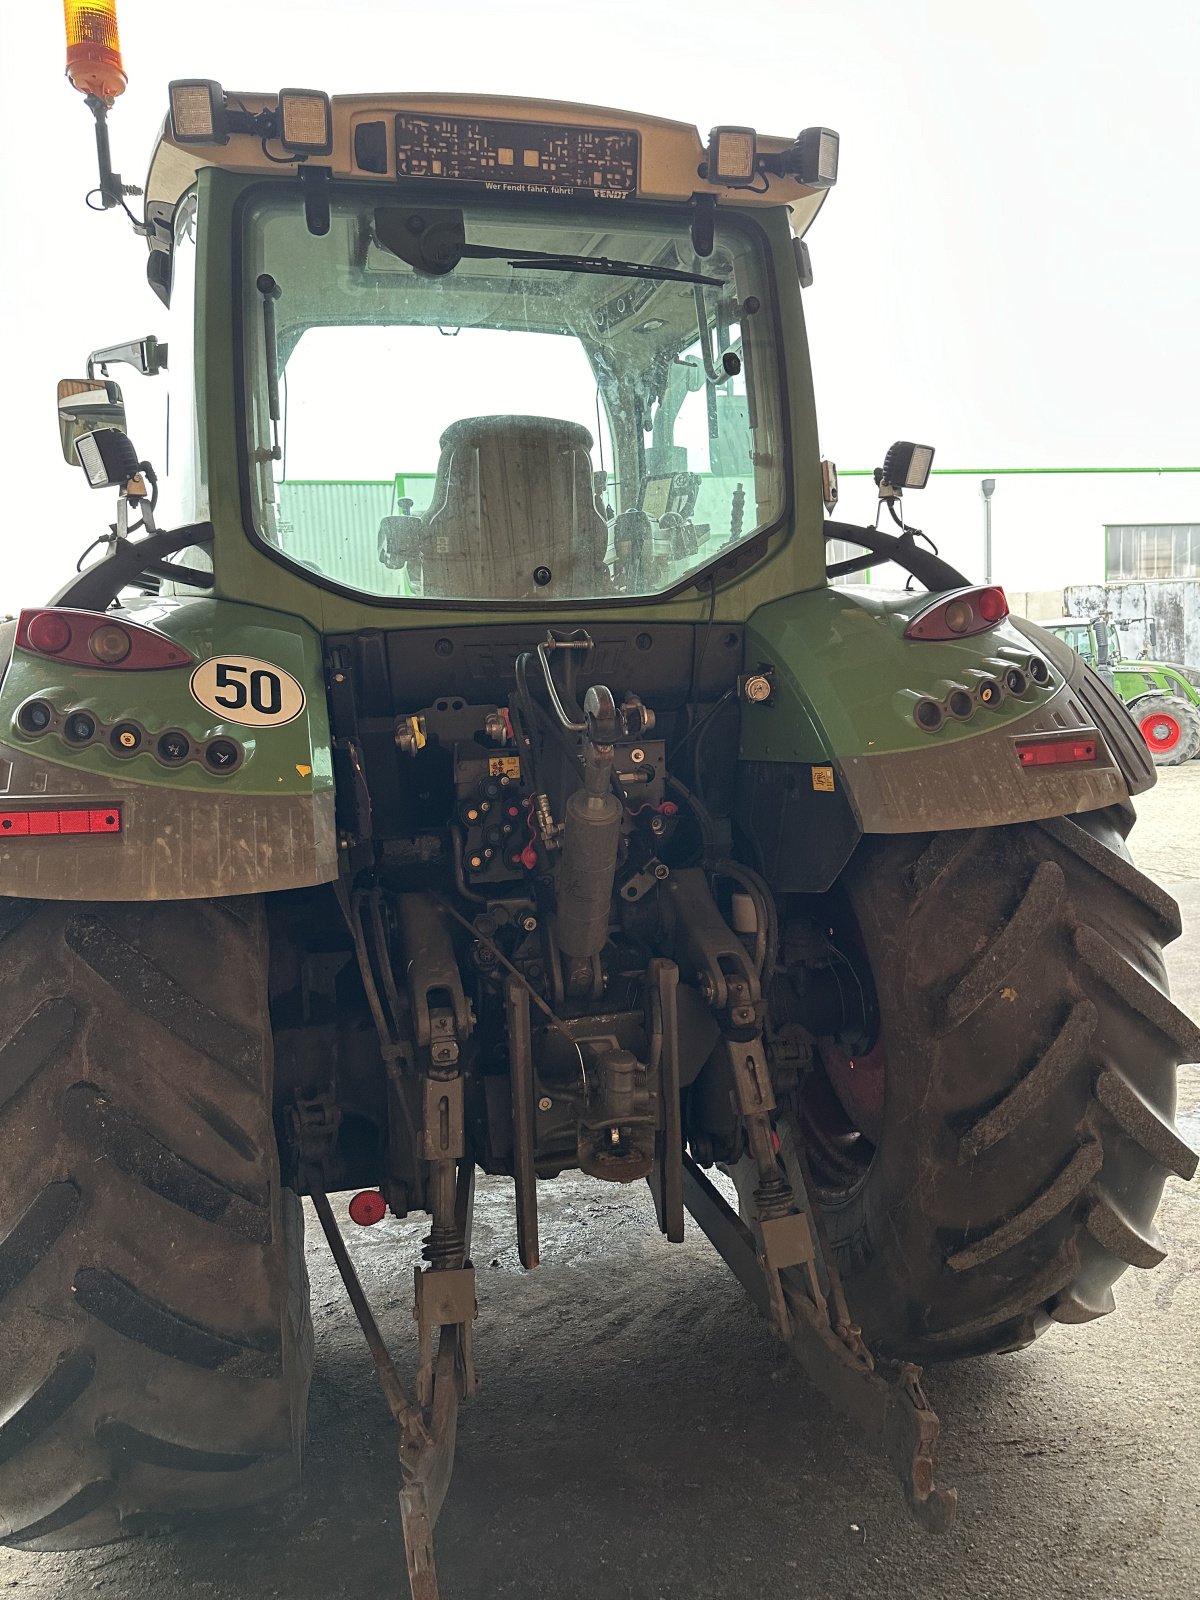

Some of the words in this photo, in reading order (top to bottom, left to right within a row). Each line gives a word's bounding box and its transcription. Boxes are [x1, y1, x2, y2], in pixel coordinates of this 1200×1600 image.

[485, 182, 501, 190] Wer
[502, 183, 526, 191] Fendt
[593, 189, 629, 199] FENDT
[215, 663, 282, 715] 50
